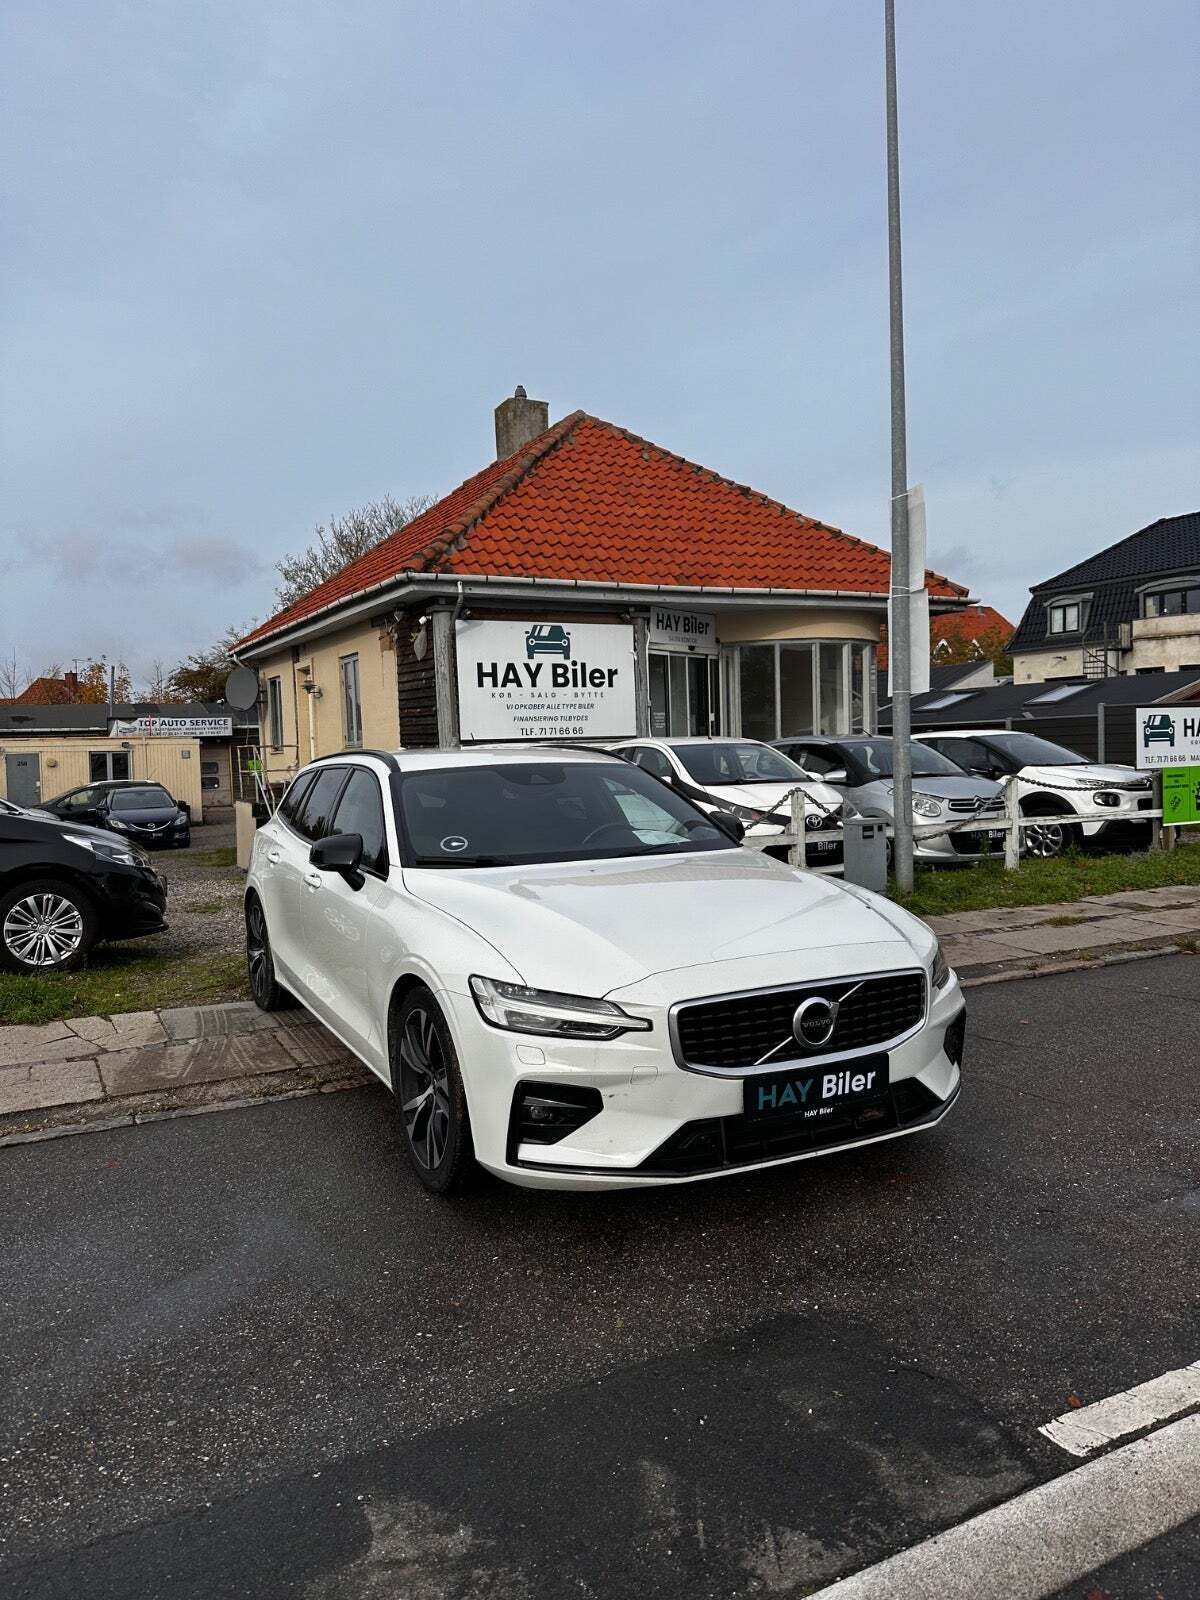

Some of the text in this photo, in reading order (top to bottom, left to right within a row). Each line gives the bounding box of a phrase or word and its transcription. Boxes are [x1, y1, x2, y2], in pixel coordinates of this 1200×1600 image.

[656, 613, 709, 635] HAY Biler
[477, 660, 618, 688] HAY Biler
[139, 718, 229, 727] TOP AUTO SERVICE
[521, 727, 584, 736] TLF. 71 71 66 66
[988, 829, 1005, 838] Biler
[817, 841, 838, 851] Biler
[802, 1018, 832, 1028] VOLVO
[758, 1071, 876, 1110] HAY Biler
[804, 1107, 834, 1118] HAY Biler
